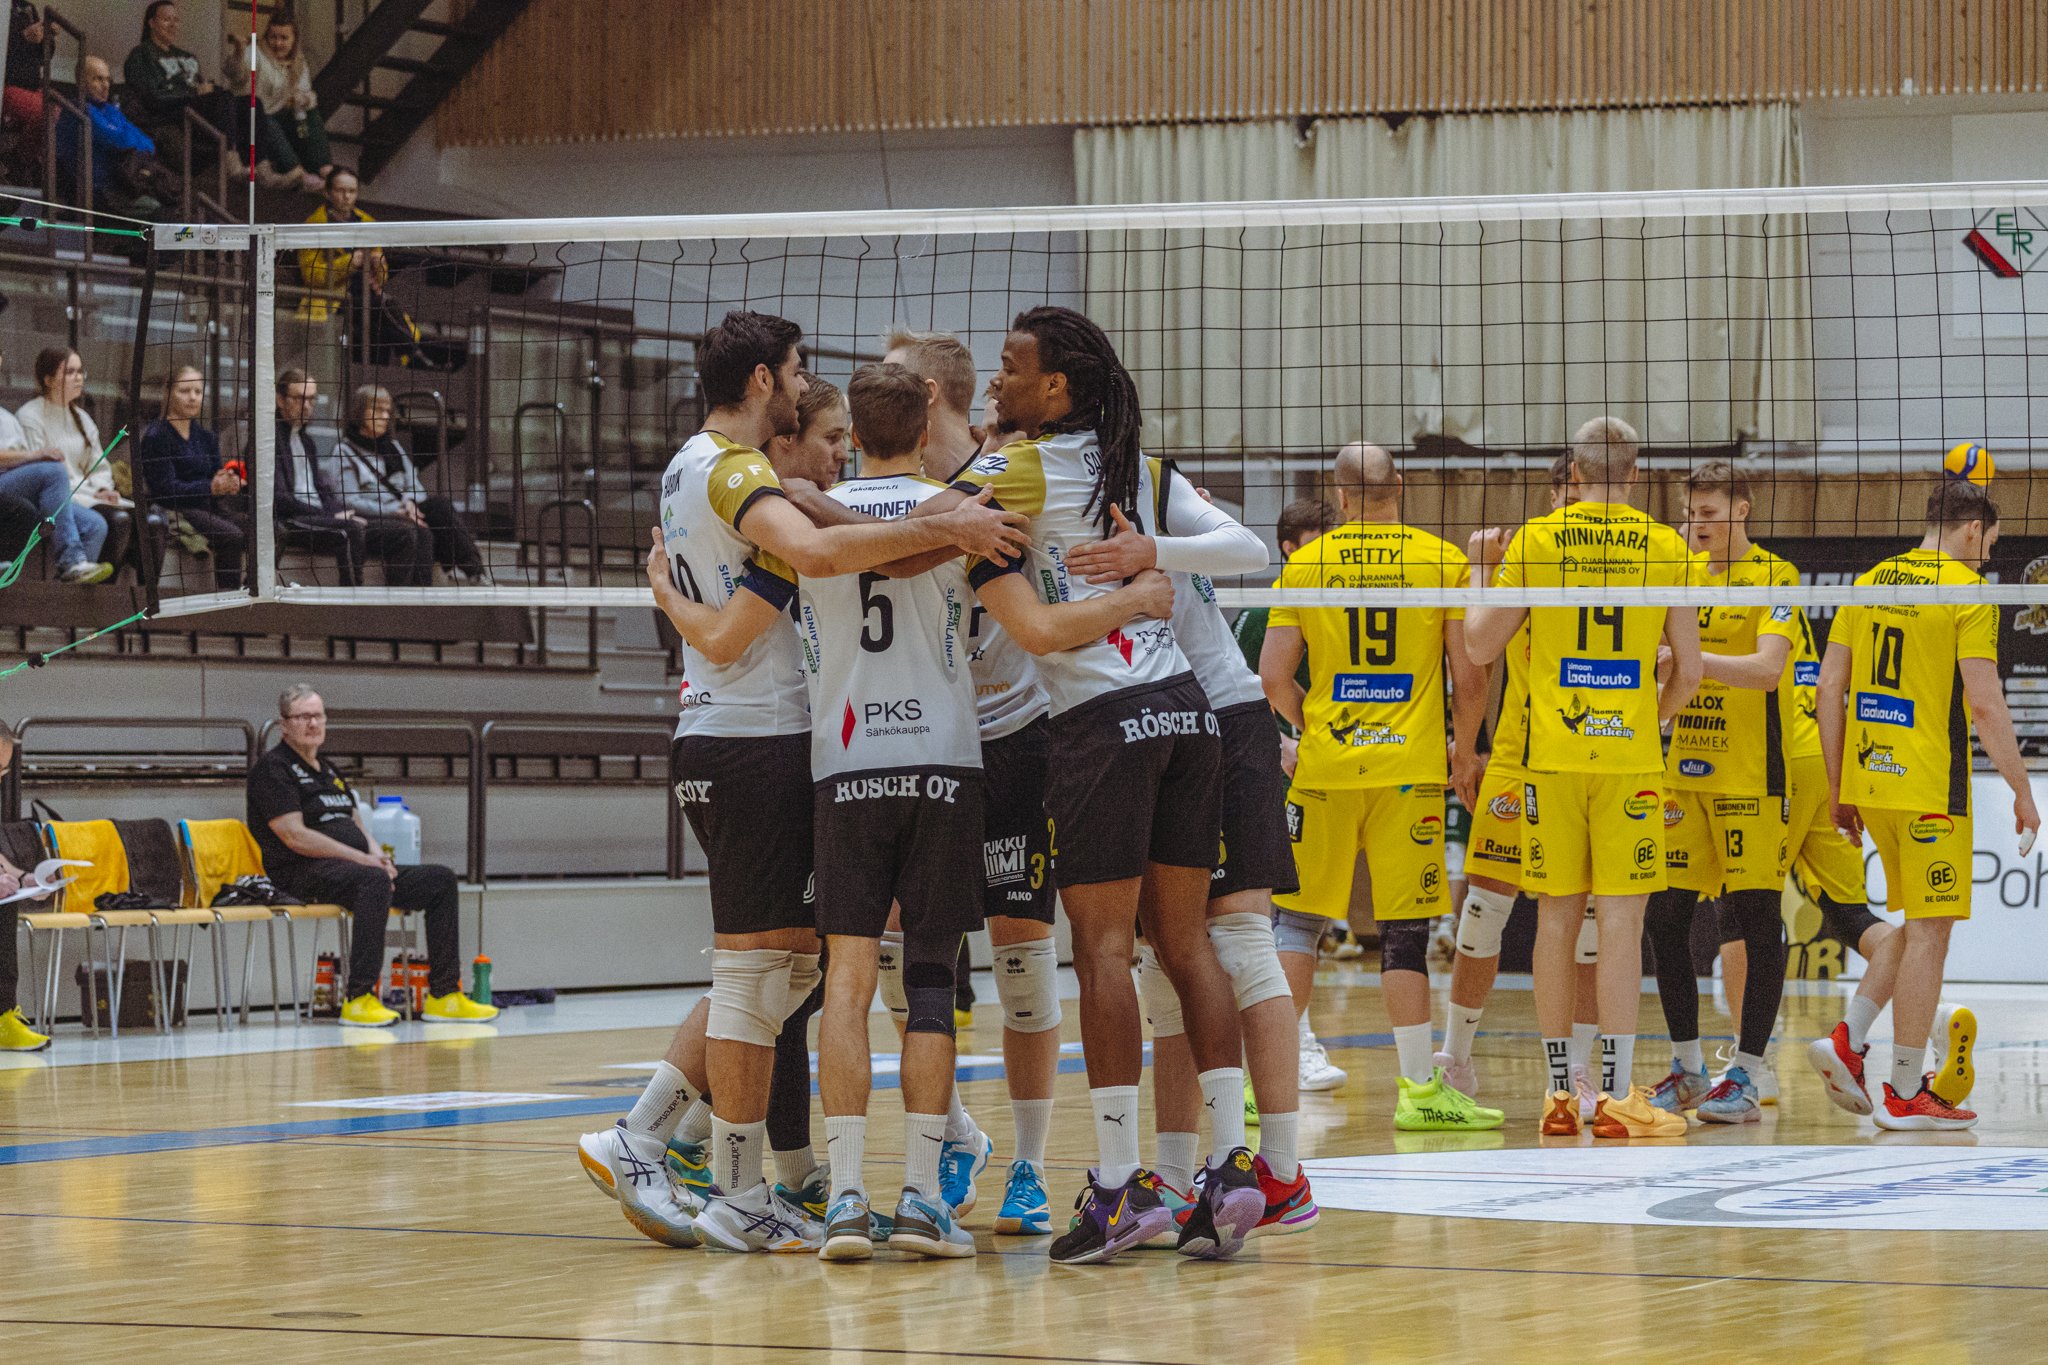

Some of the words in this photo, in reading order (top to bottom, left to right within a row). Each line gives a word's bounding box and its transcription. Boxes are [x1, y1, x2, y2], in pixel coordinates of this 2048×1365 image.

[1554, 527, 1649, 551] NIINIVAARA
[1339, 547, 1401, 565] PETTY
[1581, 566, 1626, 576] RAKENNUS
[1628, 566, 1641, 575] OY
[859, 570, 894, 653] 5
[1576, 586, 1625, 652] 14
[944, 587, 956, 668] SUOMALAINEN
[1343, 607, 1397, 667] 19
[1871, 621, 1905, 691] 10
[1567, 669, 1632, 686] Laatuauto
[1340, 685, 1405, 700] Laatuauto
[864, 699, 923, 725] PKS
[1584, 714, 1609, 726] Ase
[1609, 715, 1623, 729] &
[865, 724, 931, 738] Sähkökauppa
[1119, 707, 1200, 744] RÖSCH
[1584, 725, 1635, 741] Retkeily
[925, 775, 960, 804] OY
[1637, 843, 1655, 864] BE
[1724, 828, 1744, 858] 13
[1030, 852, 1046, 890] 3
[1423, 872, 1439, 889] BE
[1630, 872, 1639, 881] BE
[1639, 871, 1657, 880] GROUP
[1930, 866, 1954, 887] BE
[1006, 890, 1033, 902] JAKO
[1924, 895, 1935, 903] BE
